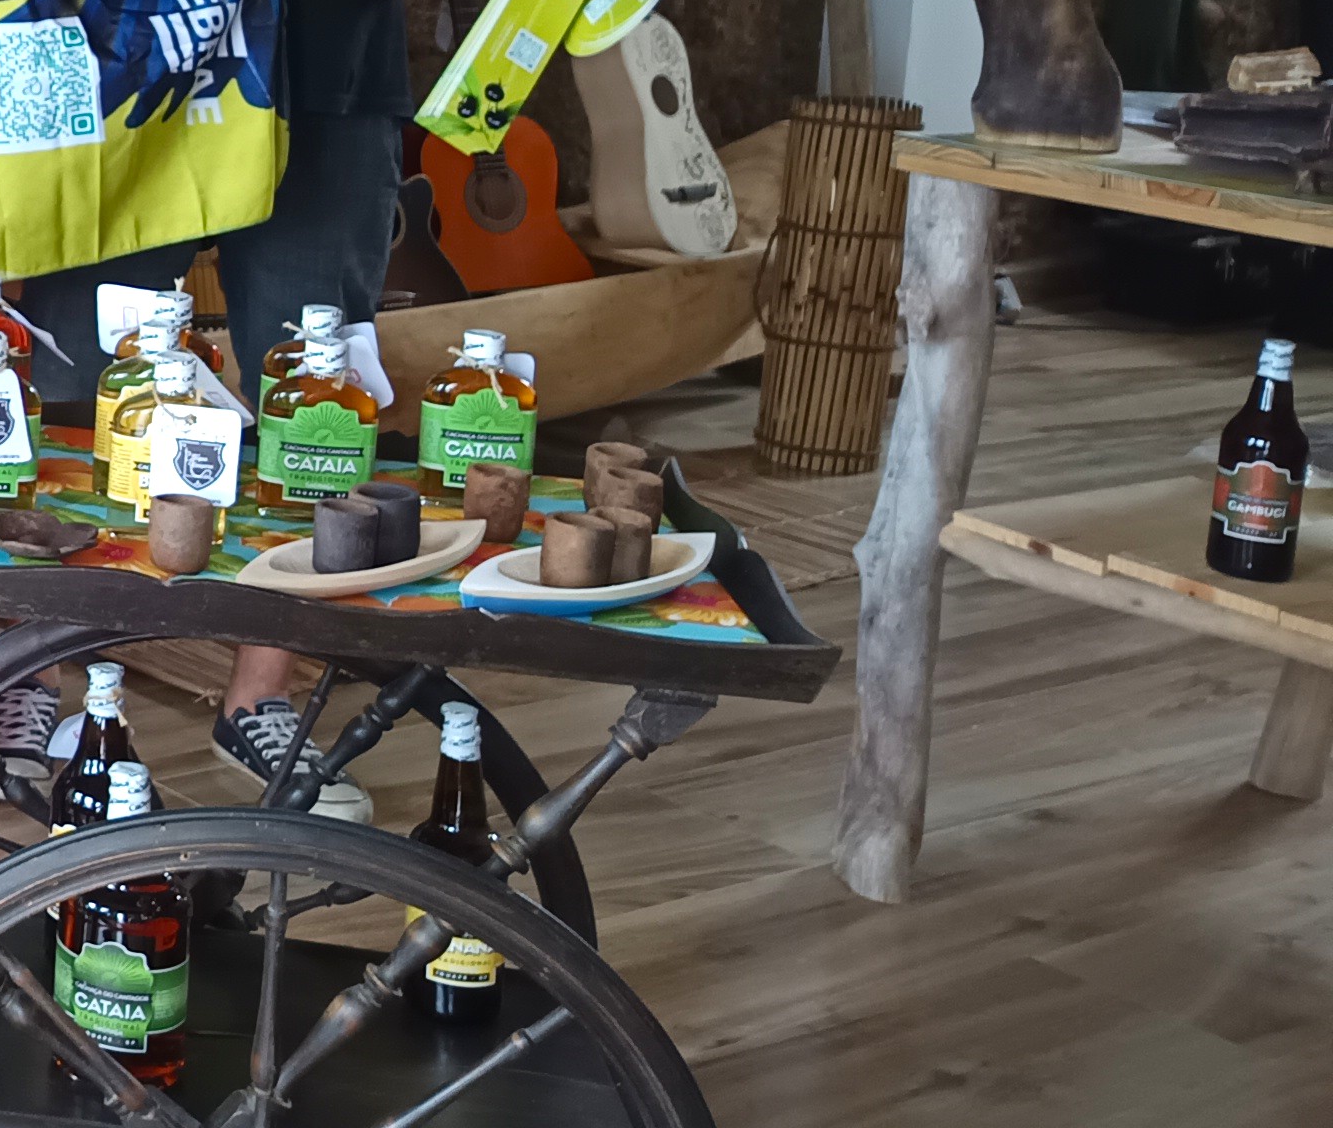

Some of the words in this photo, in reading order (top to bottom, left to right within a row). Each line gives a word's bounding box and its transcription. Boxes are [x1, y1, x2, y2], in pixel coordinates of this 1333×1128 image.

[444, 439, 517, 460] CATAIA
[283, 453, 357, 474] CATAIA
[75, 991, 146, 1021] CATAIA
